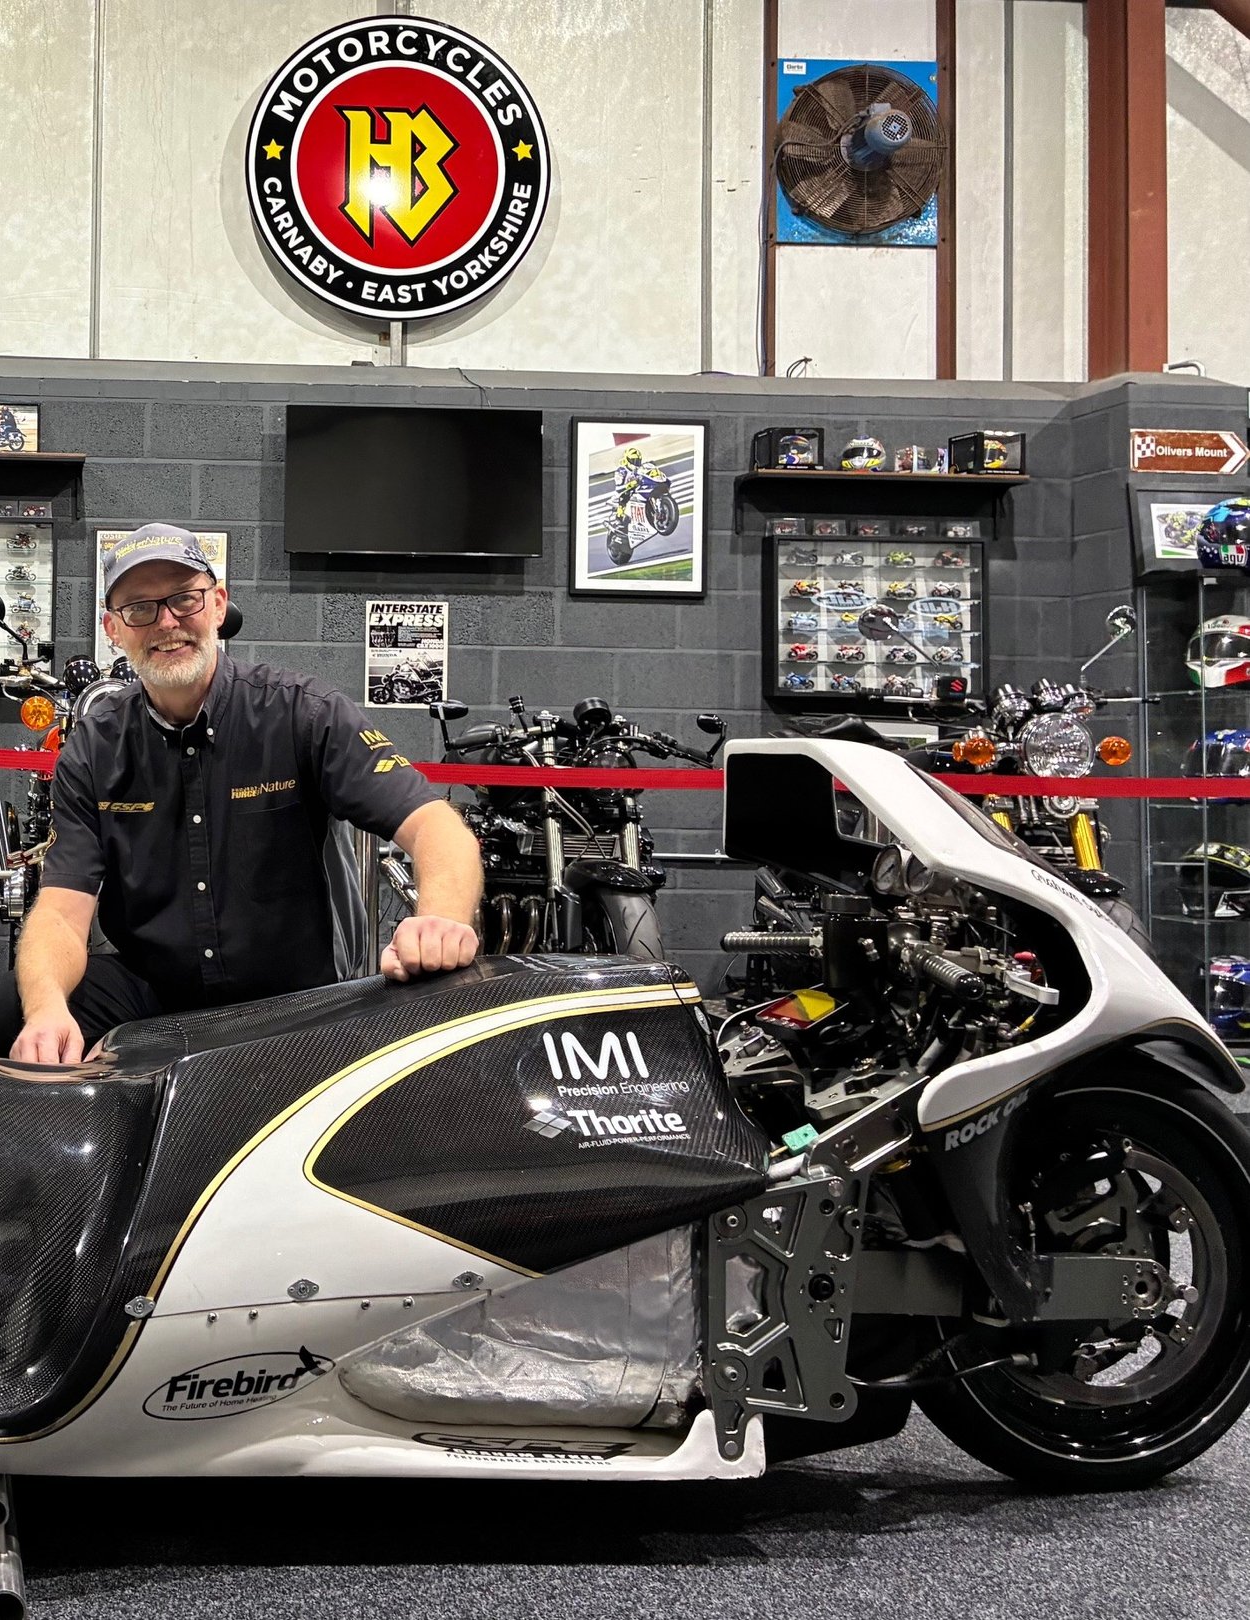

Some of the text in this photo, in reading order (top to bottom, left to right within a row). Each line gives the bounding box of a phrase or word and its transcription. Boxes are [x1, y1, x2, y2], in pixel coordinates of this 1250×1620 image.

[271, 29, 522, 126] MOTORCYCLES
[336, 105, 458, 246] HB
[263, 177, 532, 303] CARNABY EAST YORKSHIRE
[1156, 445, 1227, 457] Olivers Mount
[371, 603, 443, 614] INTERSTATE
[370, 613, 444, 627] EXPRESS
[260, 779, 296, 793] Nature
[542, 1031, 649, 1080] IMI
[557, 1079, 690, 1097] Precision Engineering
[565, 1108, 687, 1137] Thorite
[944, 1106, 1002, 1151] ROCK
[165, 1368, 303, 1402] Firebird
[162, 1404, 178, 1412] The
[179, 1403, 207, 1411] Future
[219, 1399, 244, 1407] Home
[245, 1394, 277, 1404] Heating
[446, 1453, 528, 1463] PERFORMANCE
[452, 1449, 535, 1458] GRAHAM
